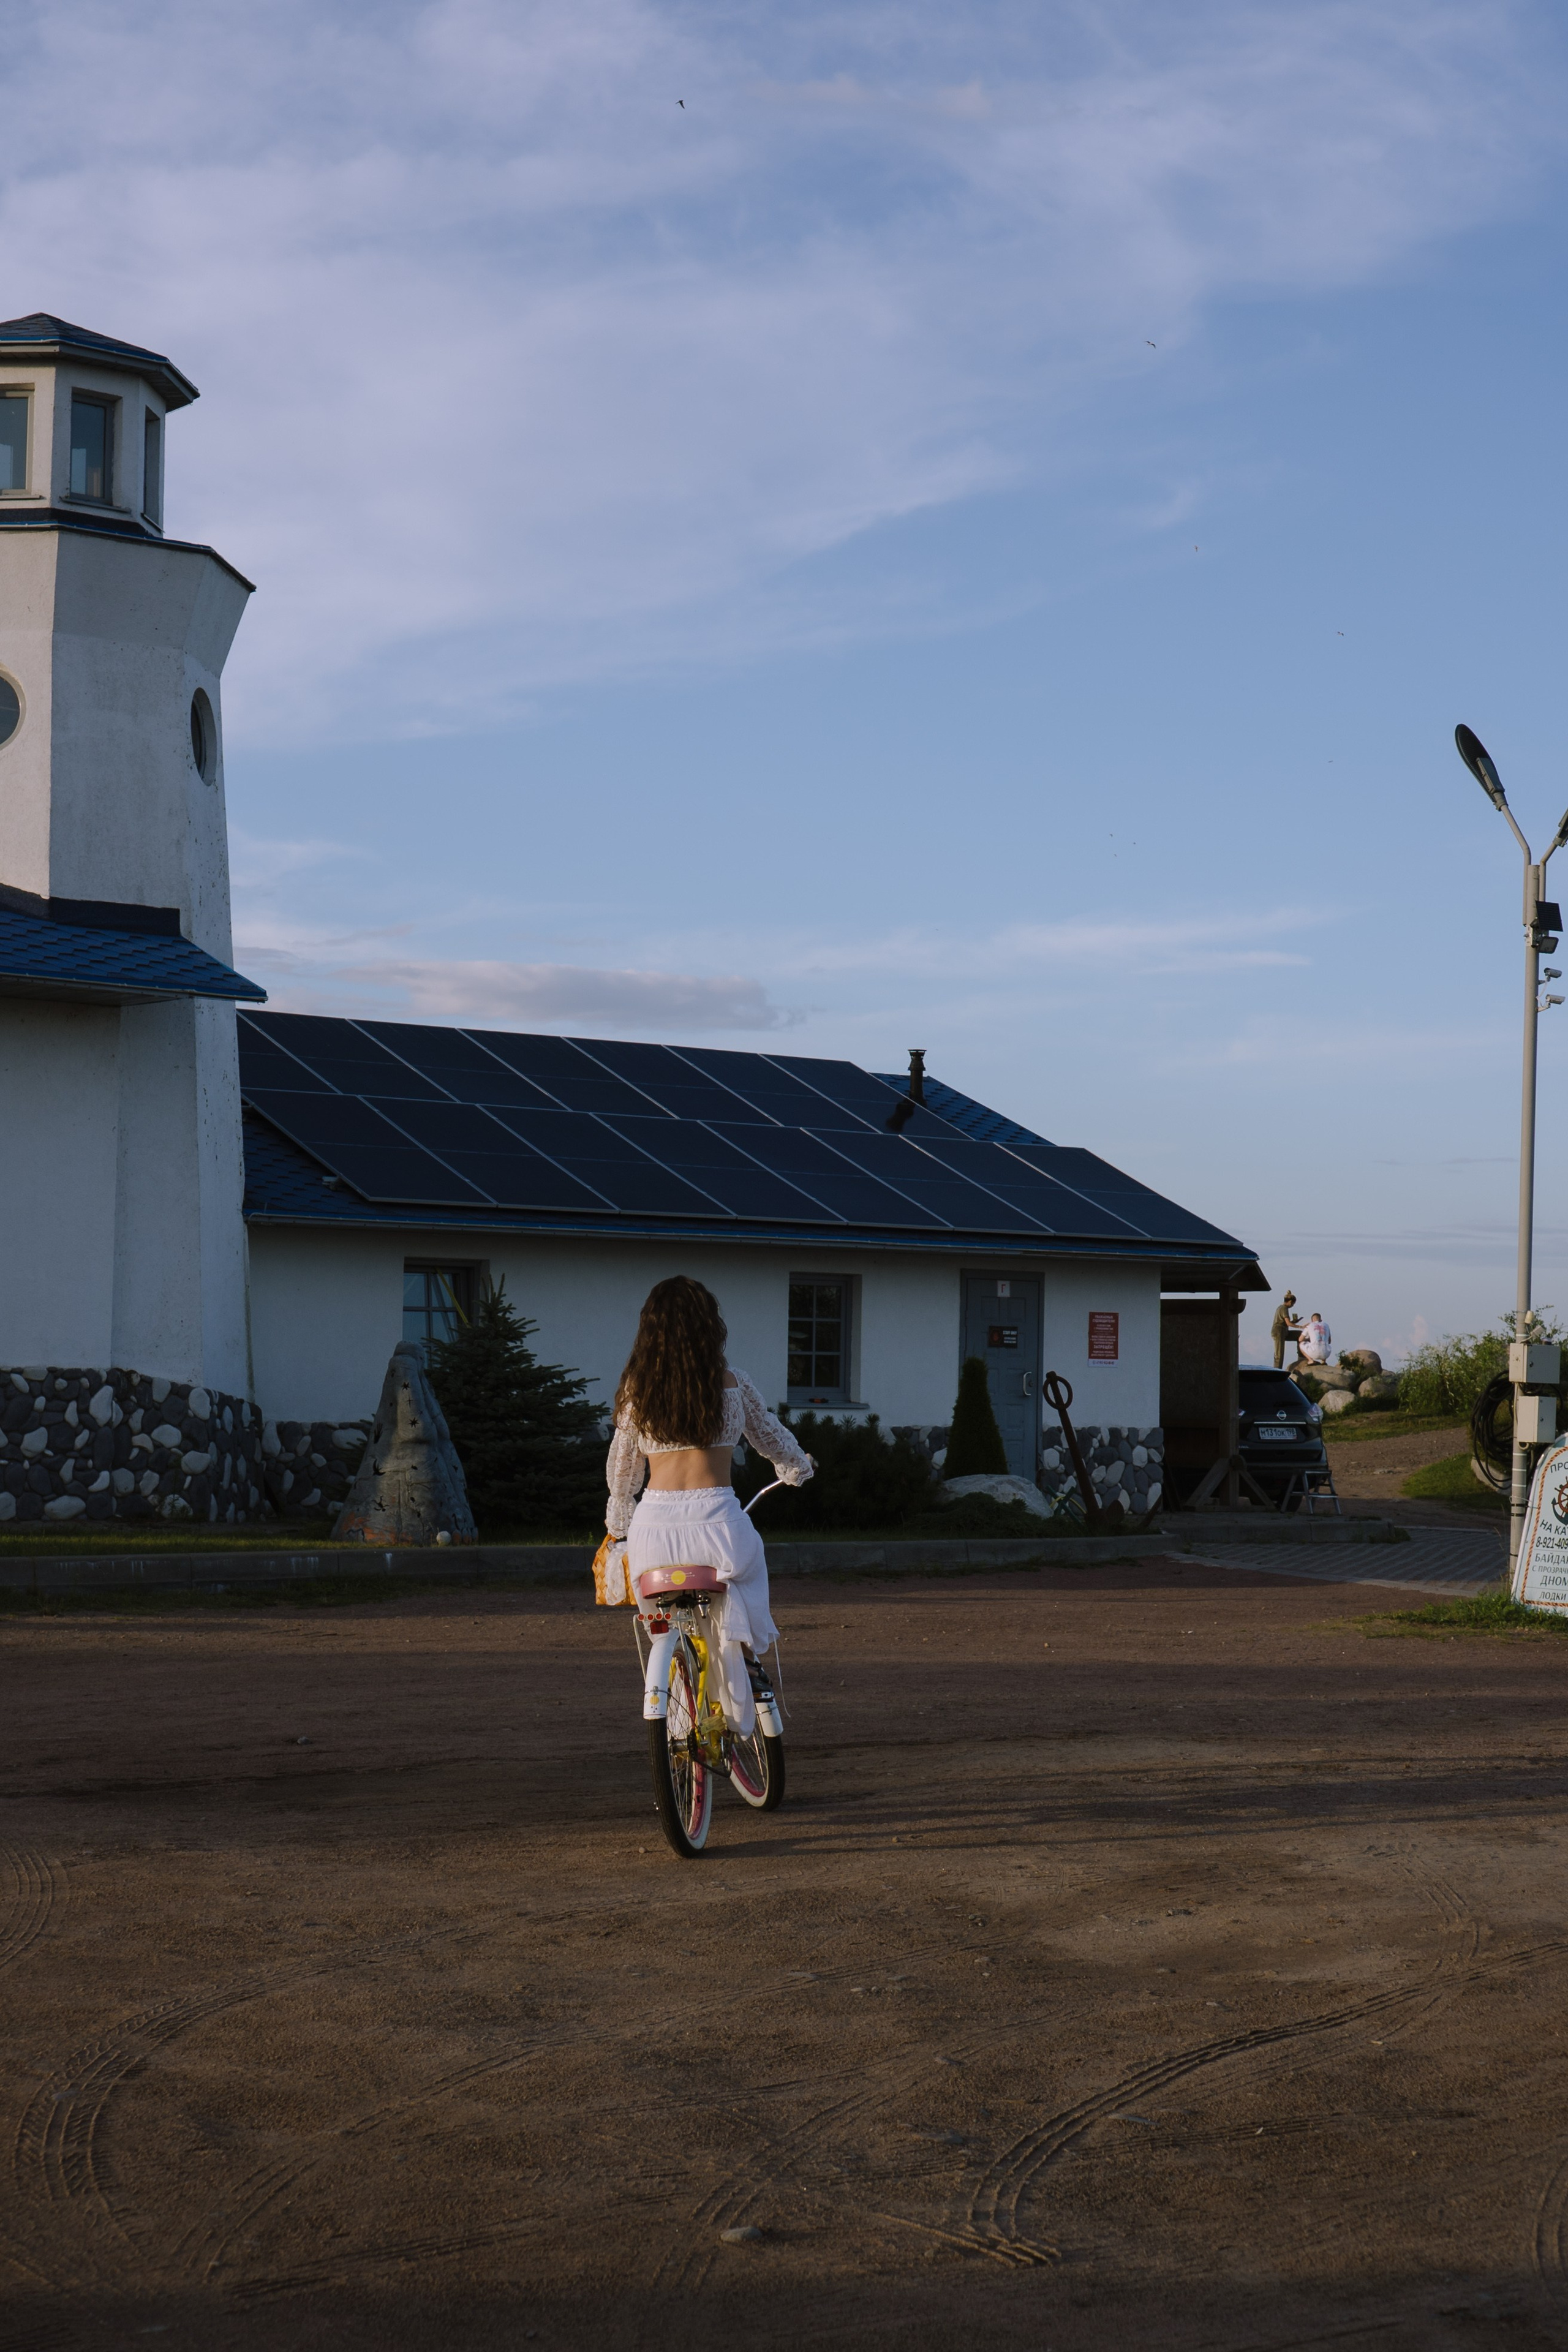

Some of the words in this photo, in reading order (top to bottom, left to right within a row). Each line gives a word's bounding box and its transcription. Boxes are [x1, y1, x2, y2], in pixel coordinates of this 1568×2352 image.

[1540, 1519, 1552, 1533] НА
[1555, 1525, 1568, 1536] КА
[1538, 1566, 1568, 1574] ПРОЗРАЧ
[1539, 1591, 1567, 1601] ЛОДКИ
